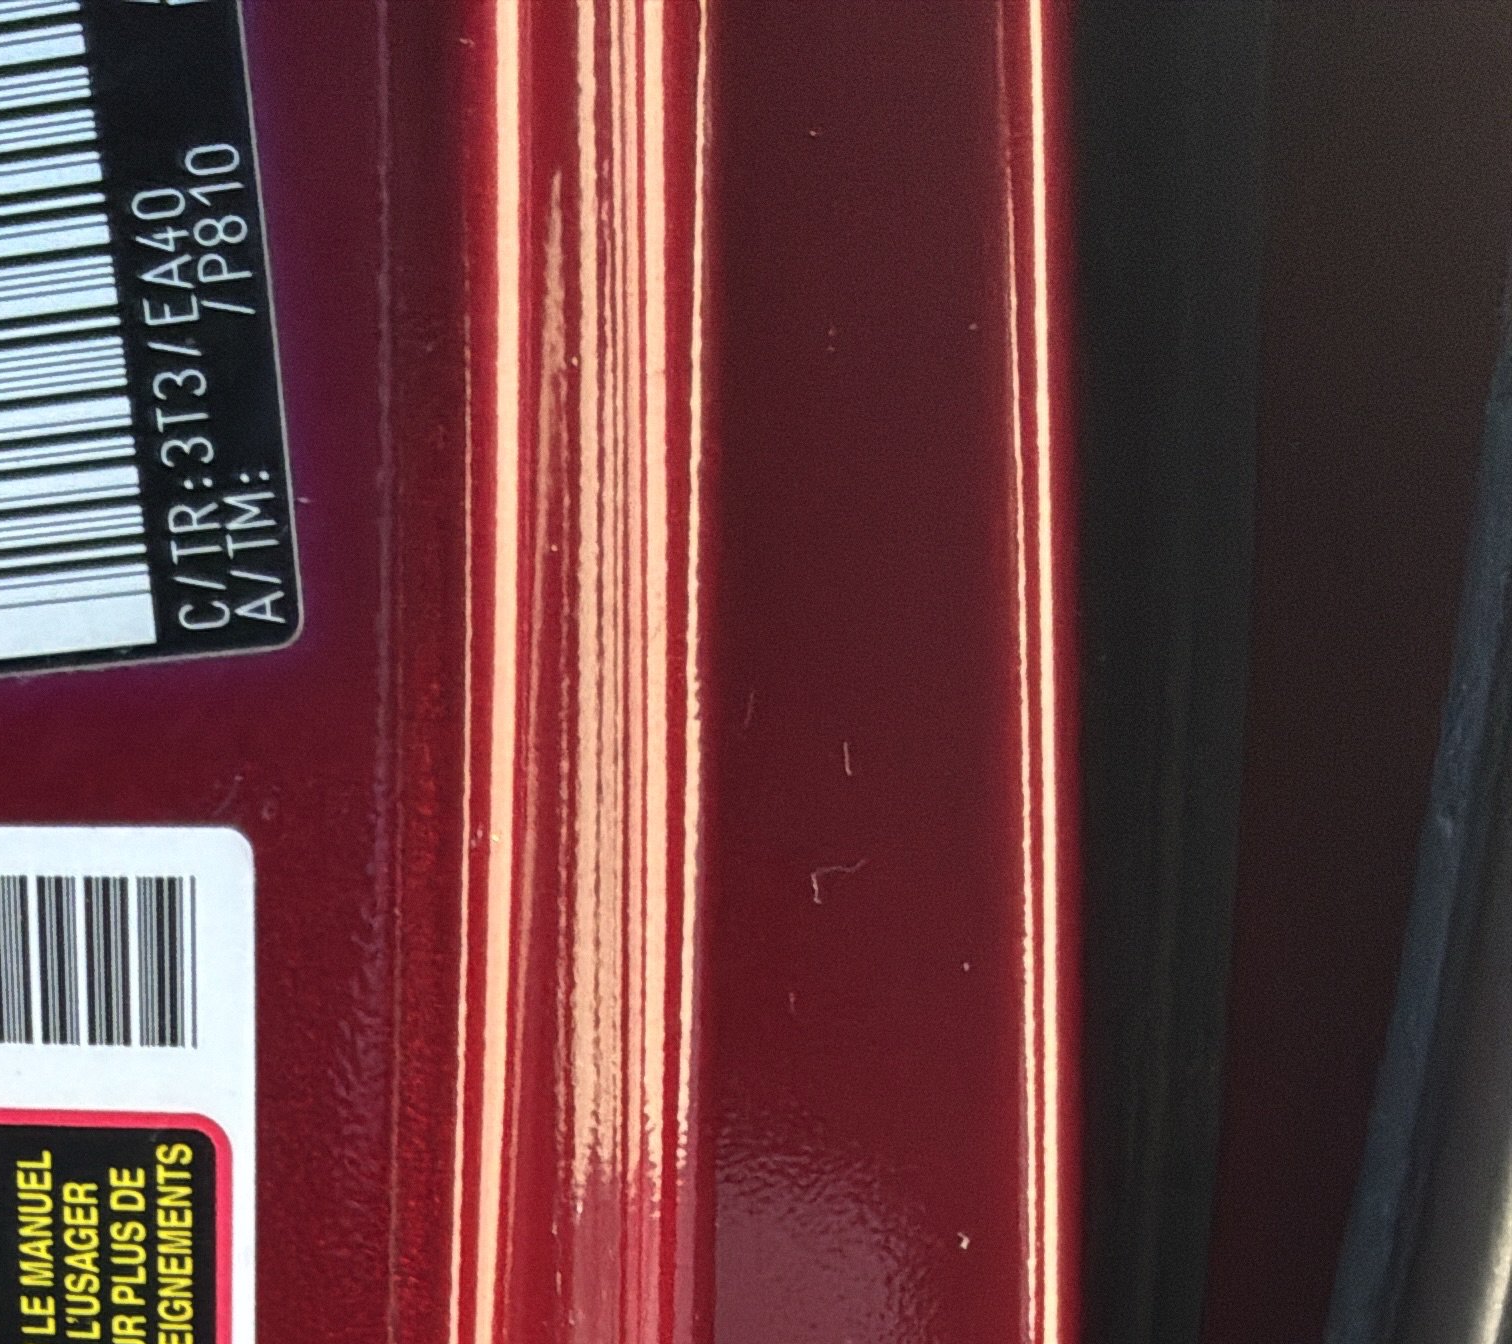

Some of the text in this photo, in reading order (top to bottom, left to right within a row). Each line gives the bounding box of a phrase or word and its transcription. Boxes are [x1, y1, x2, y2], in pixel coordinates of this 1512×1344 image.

[15, 1149, 55, 1287] MANUEL
[108, 1166, 146, 1212] DE
[108, 1219, 147, 1306] PLUS
[19, 1294, 57, 1335] LE
